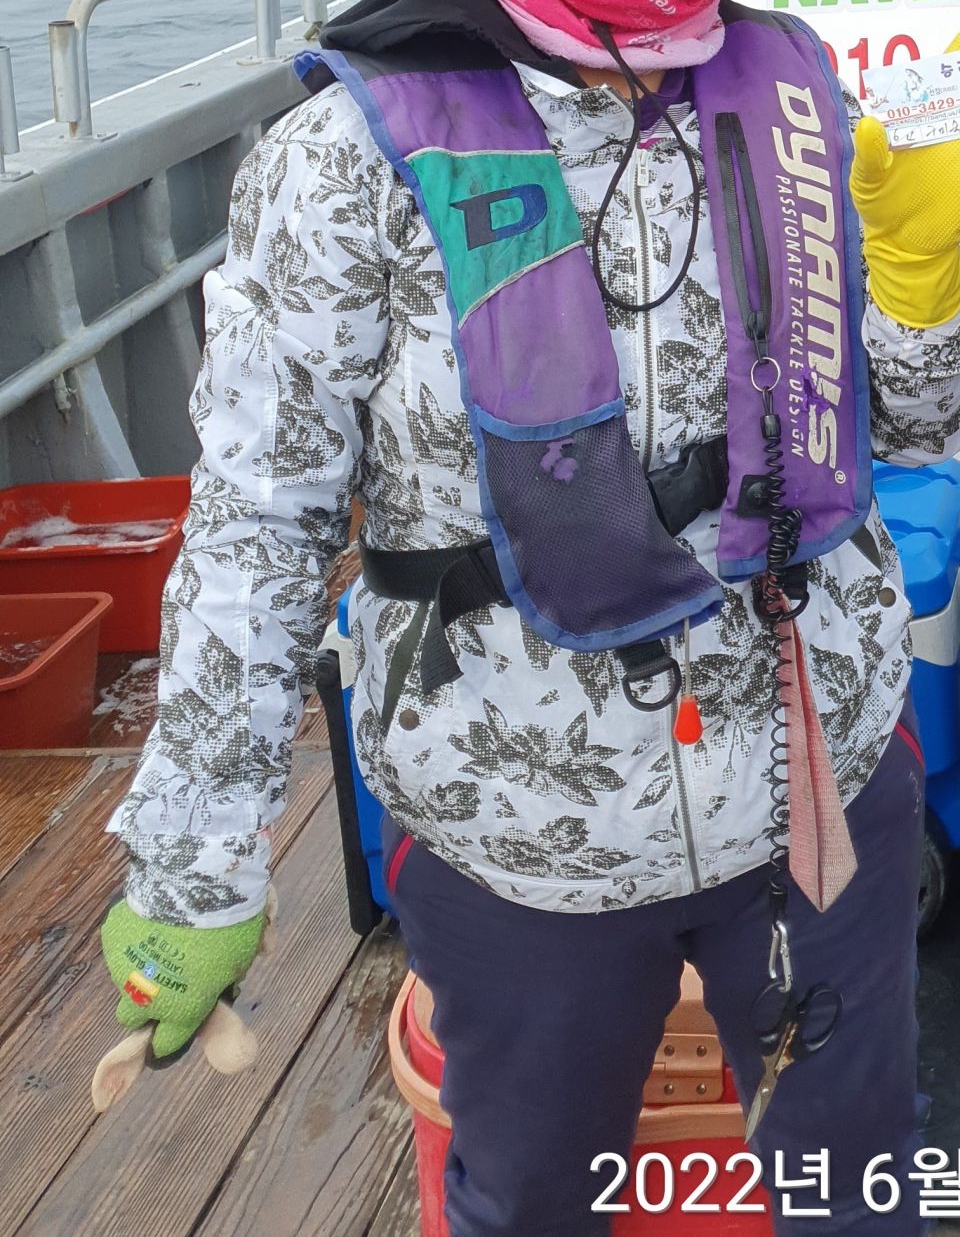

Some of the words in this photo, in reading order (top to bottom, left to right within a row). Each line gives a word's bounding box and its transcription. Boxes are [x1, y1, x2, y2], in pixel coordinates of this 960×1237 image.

[775, 174, 803, 288] PASSIONATE
[789, 295, 804, 369] TACKLE
[123, 945, 146, 971] GLOVE
[153, 973, 188, 994] SAFETY
